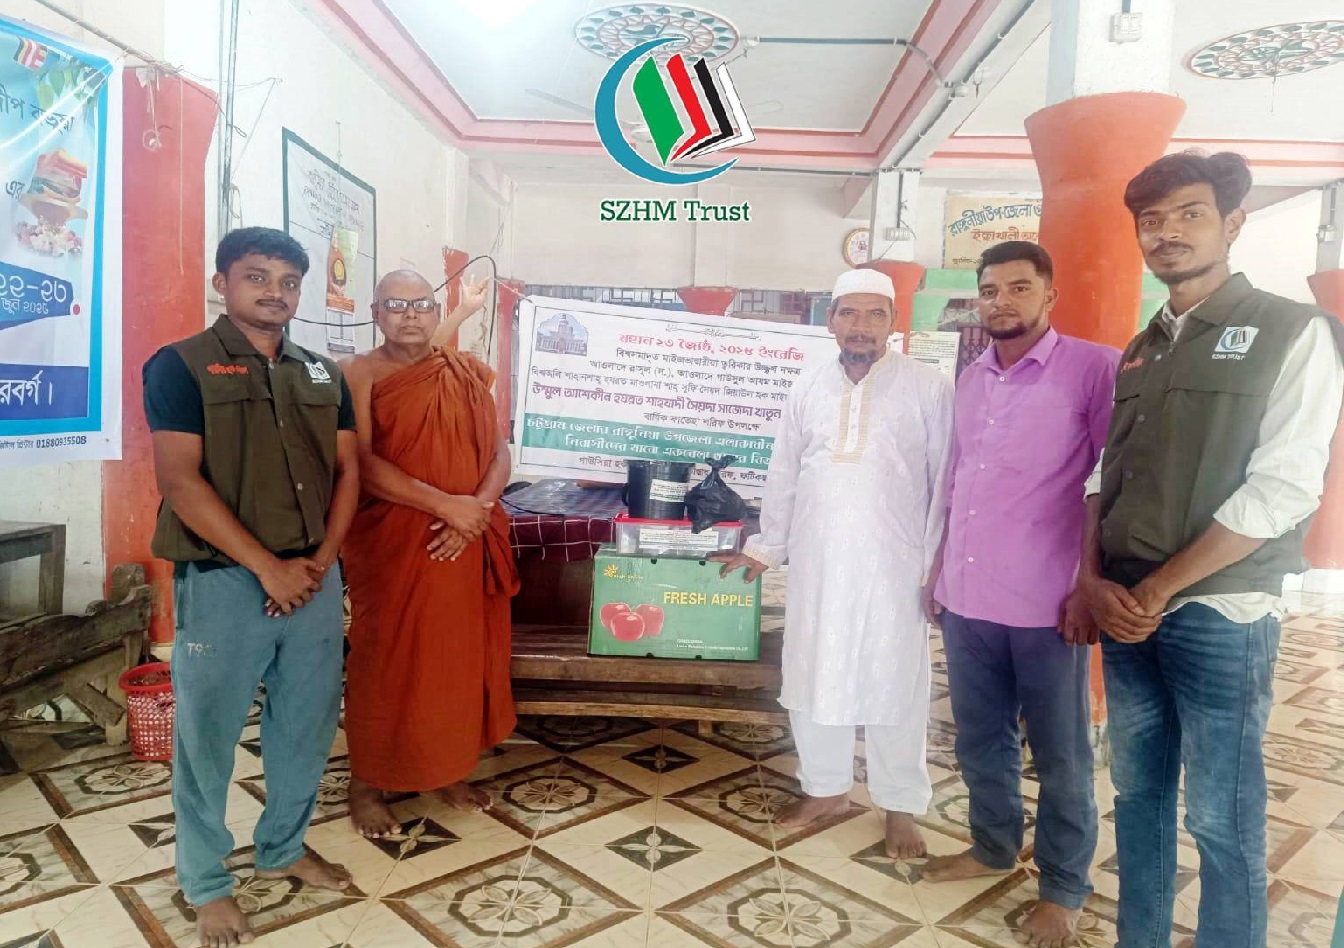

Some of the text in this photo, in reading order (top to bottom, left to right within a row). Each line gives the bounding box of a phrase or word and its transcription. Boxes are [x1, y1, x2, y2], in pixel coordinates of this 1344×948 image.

[1, 297, 20, 315] জুন
[663, 591, 754, 607] FRESH APPLE
